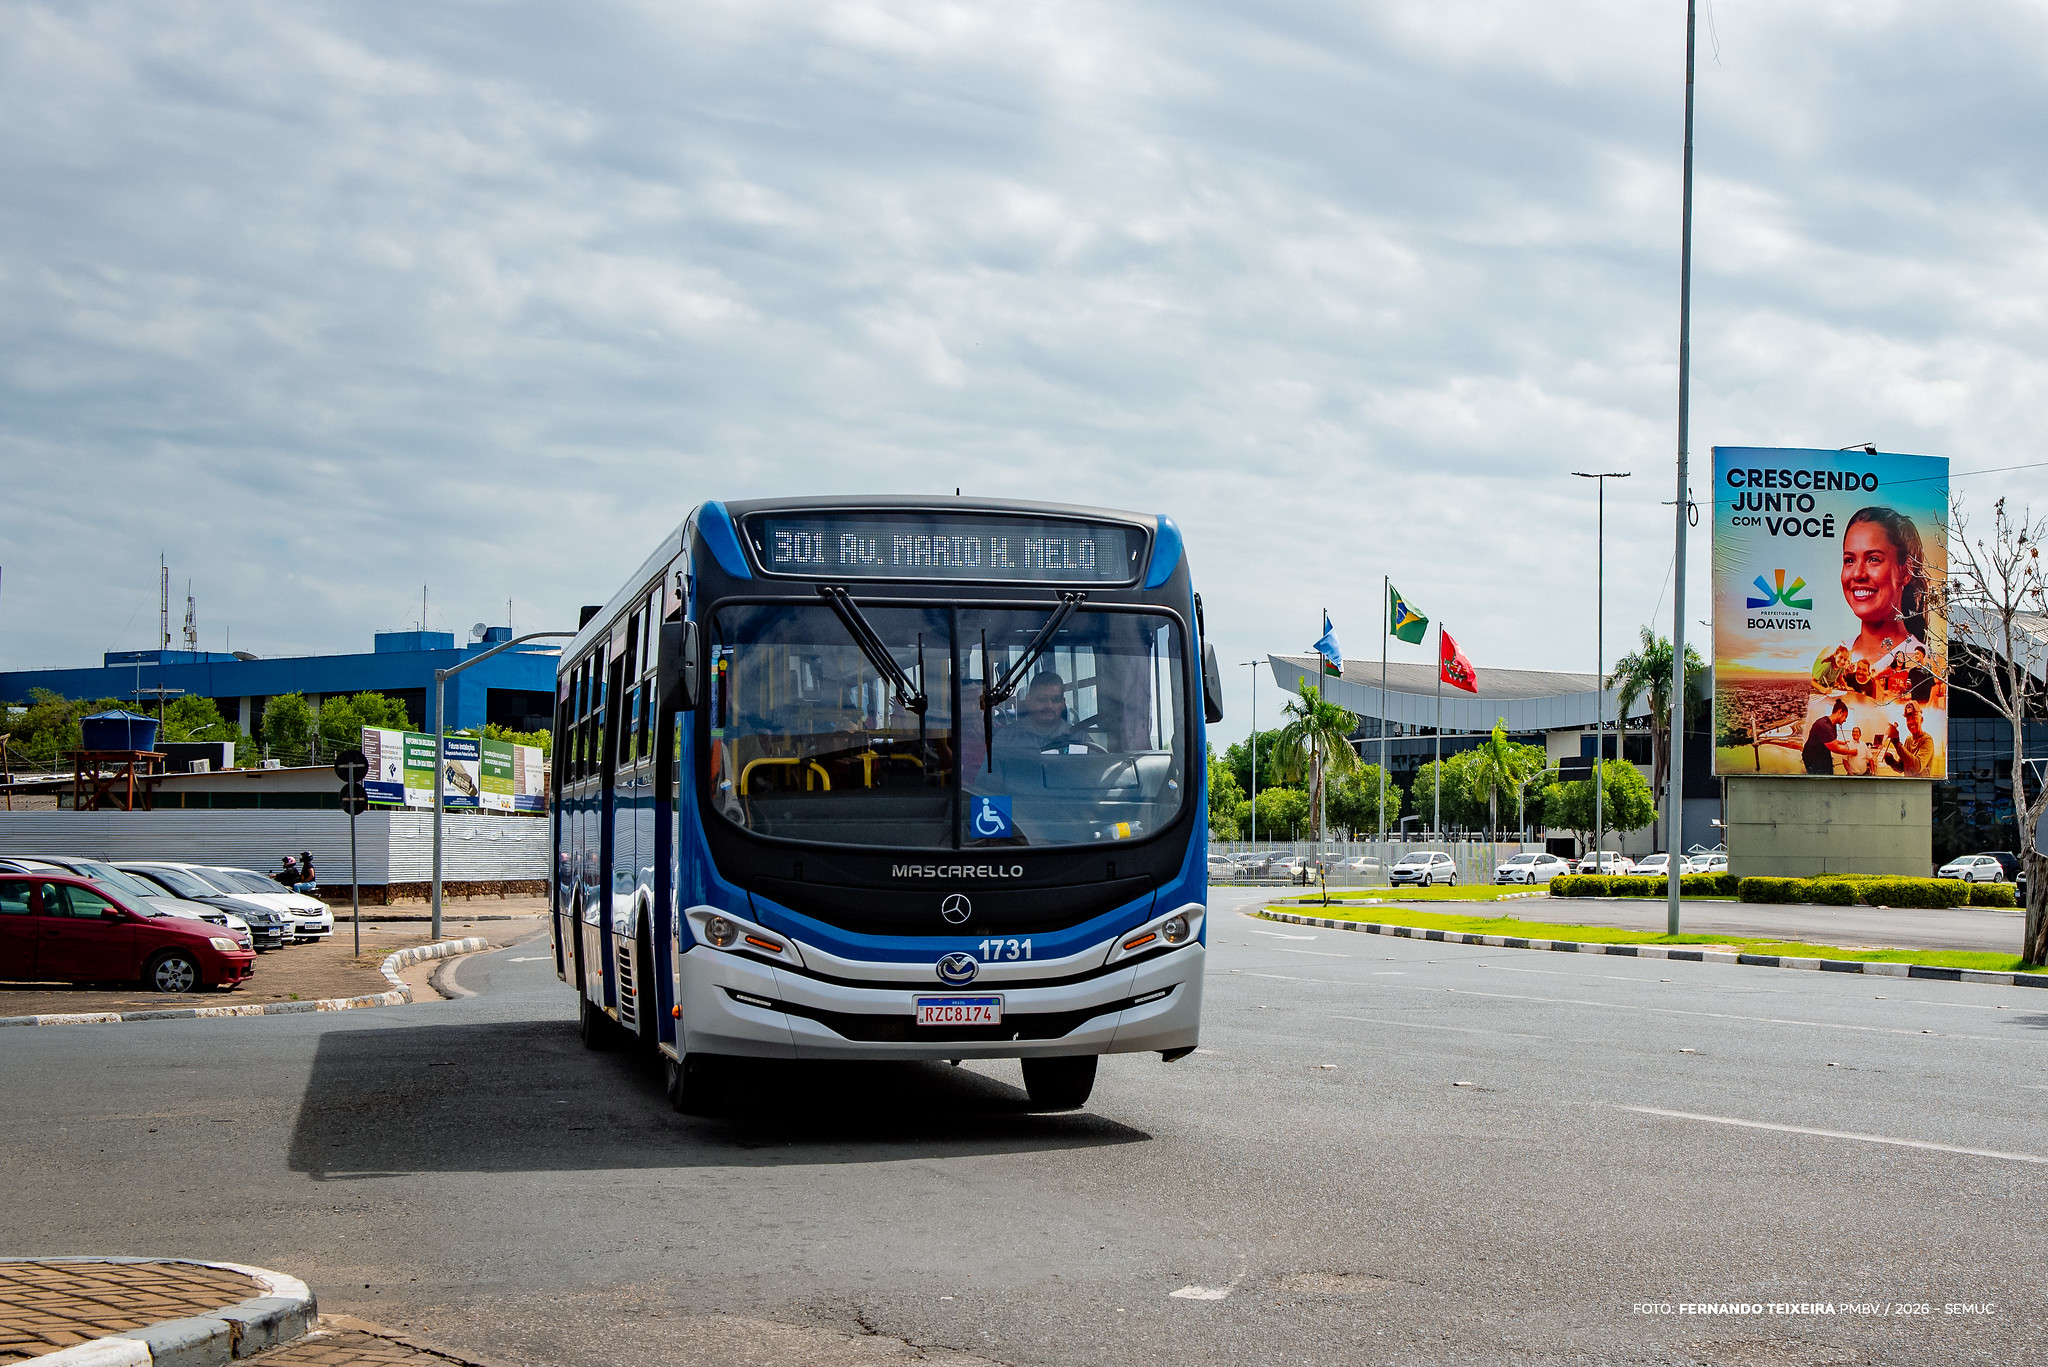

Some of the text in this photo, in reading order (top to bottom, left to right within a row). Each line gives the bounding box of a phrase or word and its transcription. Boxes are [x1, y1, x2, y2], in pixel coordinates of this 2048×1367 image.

[1726, 468, 1879, 492] CRESCENDO
[1731, 492, 1815, 513] JUNTO
[1731, 513, 1835, 538] COM VOCÊ
[775, 531, 825, 563] 301
[893, 535, 981, 567] MARIO
[990, 537, 1015, 568] H.
[1024, 538, 1095, 569] MELO
[892, 865, 1023, 878] MASCARELLO
[978, 938, 1032, 960] 1731
